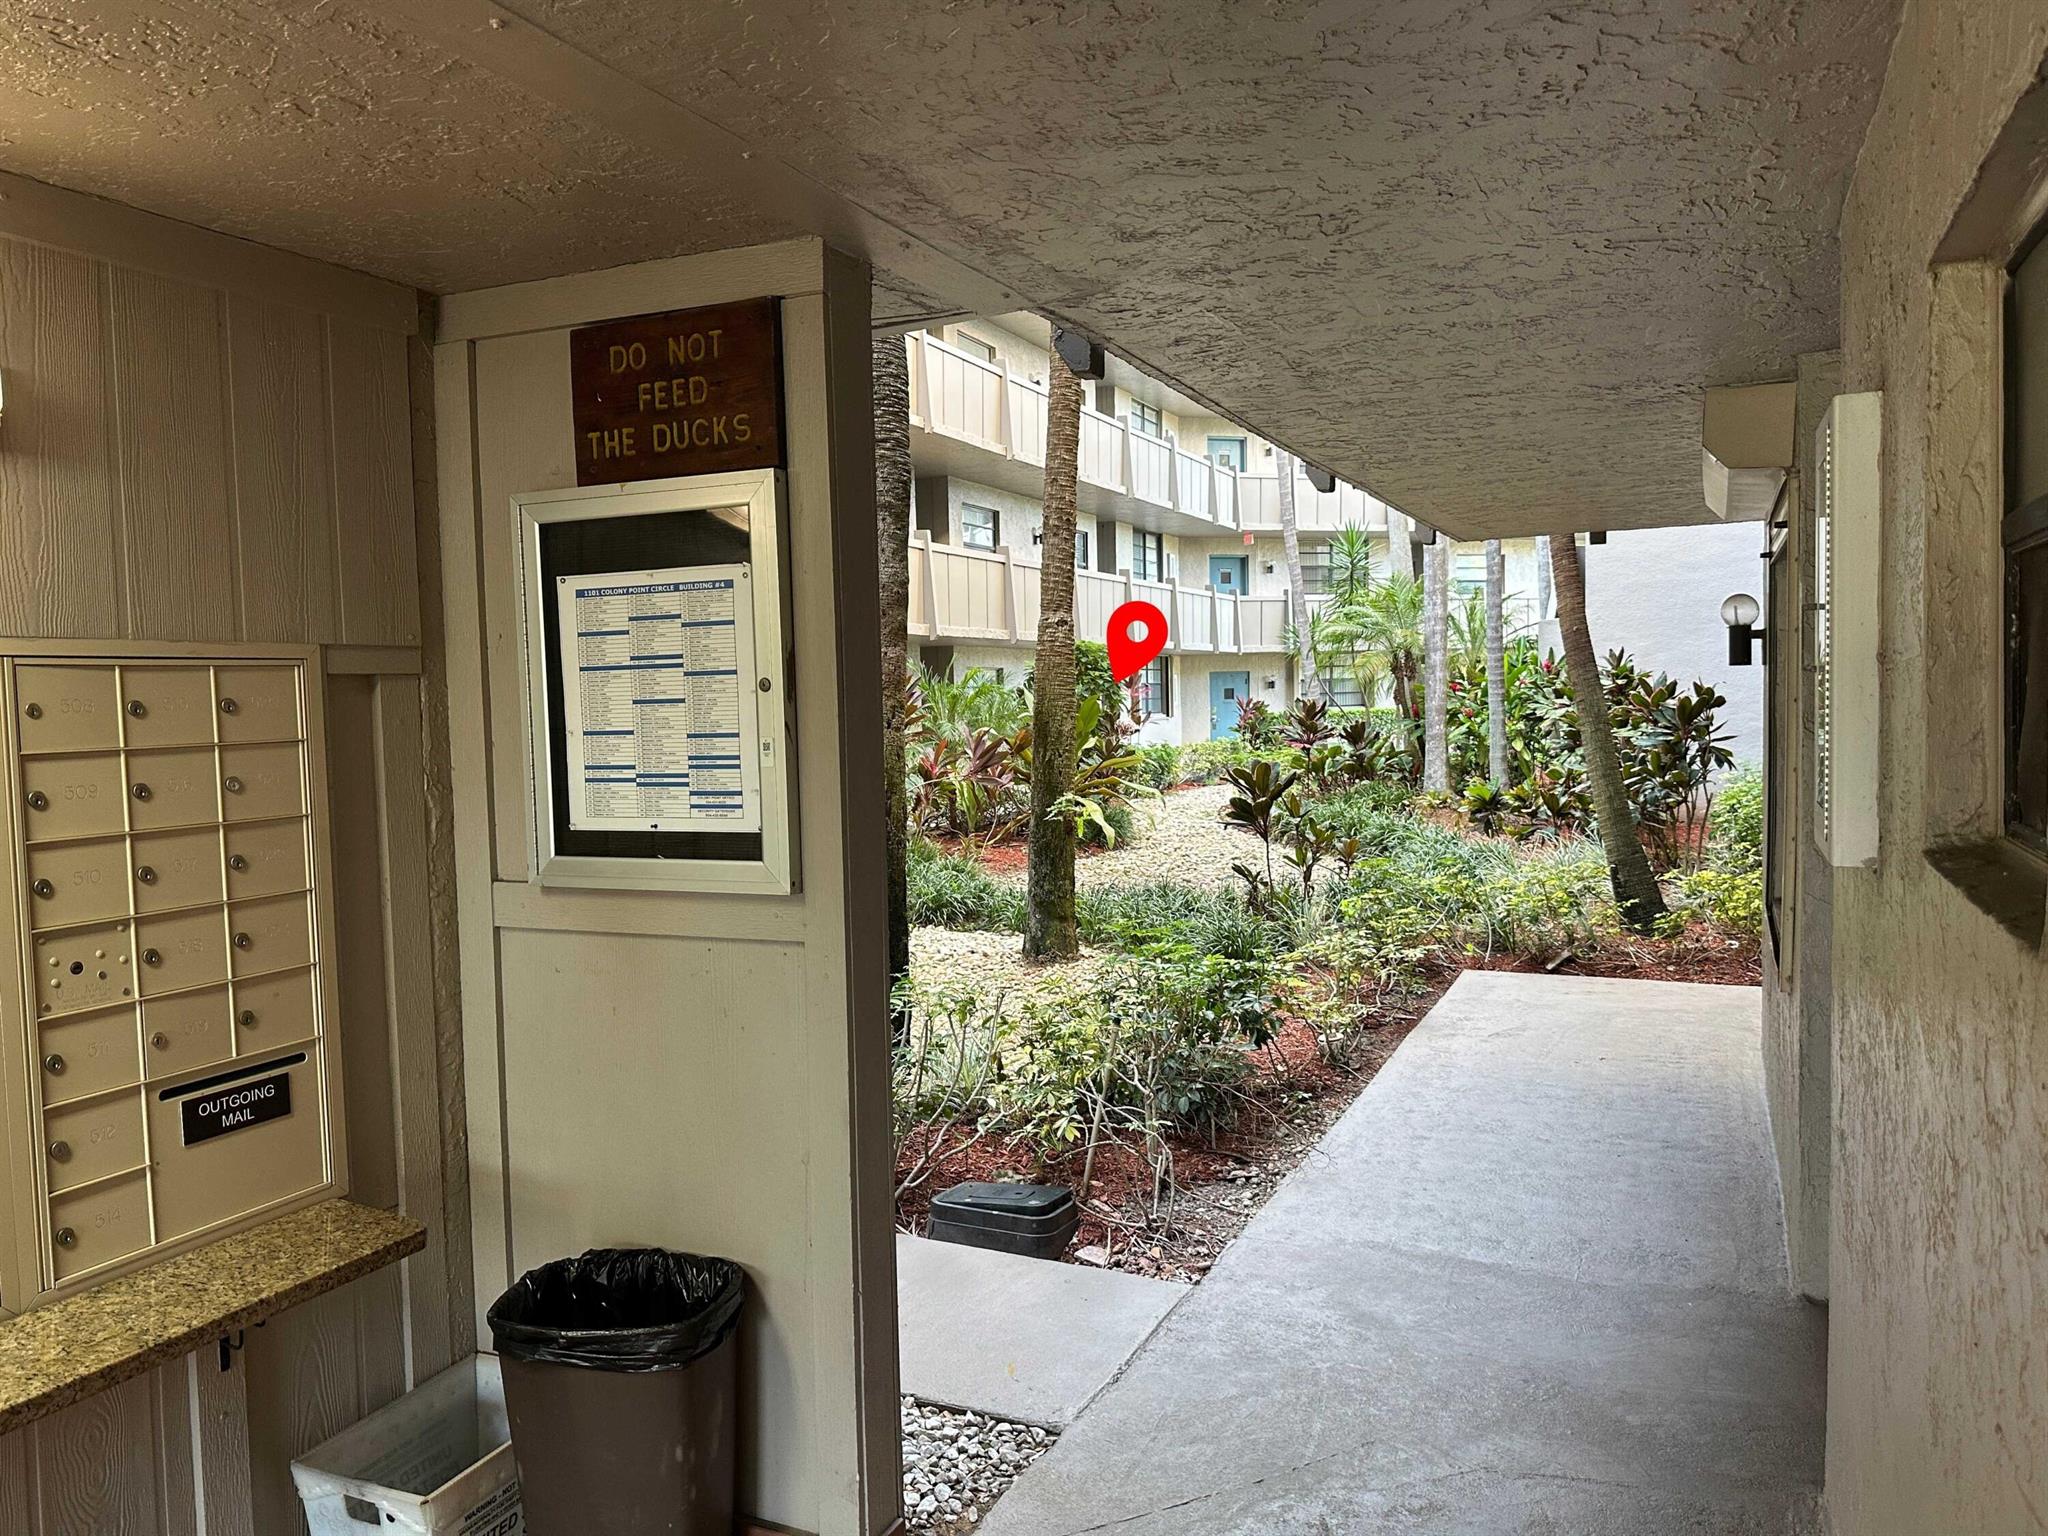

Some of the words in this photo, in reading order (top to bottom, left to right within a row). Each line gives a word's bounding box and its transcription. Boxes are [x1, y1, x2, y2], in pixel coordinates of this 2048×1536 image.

[608, 342, 646, 375] DO
[667, 329, 722, 366] NOT
[637, 375, 709, 412] FEED
[587, 428, 637, 461] THE
[652, 413, 751, 453] DUCKS
[600, 588, 628, 596] COLONY
[628, 586, 650, 594] POINT
[650, 584, 675, 593] CIRCLE
[679, 581, 714, 591] BUILDING
[64, 783, 99, 801] 509
[72, 868, 102, 887] 510
[198, 1084, 275, 1117] OUTGOING
[221, 1107, 256, 1128] MAIL
[463, 1494, 498, 1523] WARNING
[502, 1480, 517, 1496] NOT
[483, 1511, 519, 1536] TED
